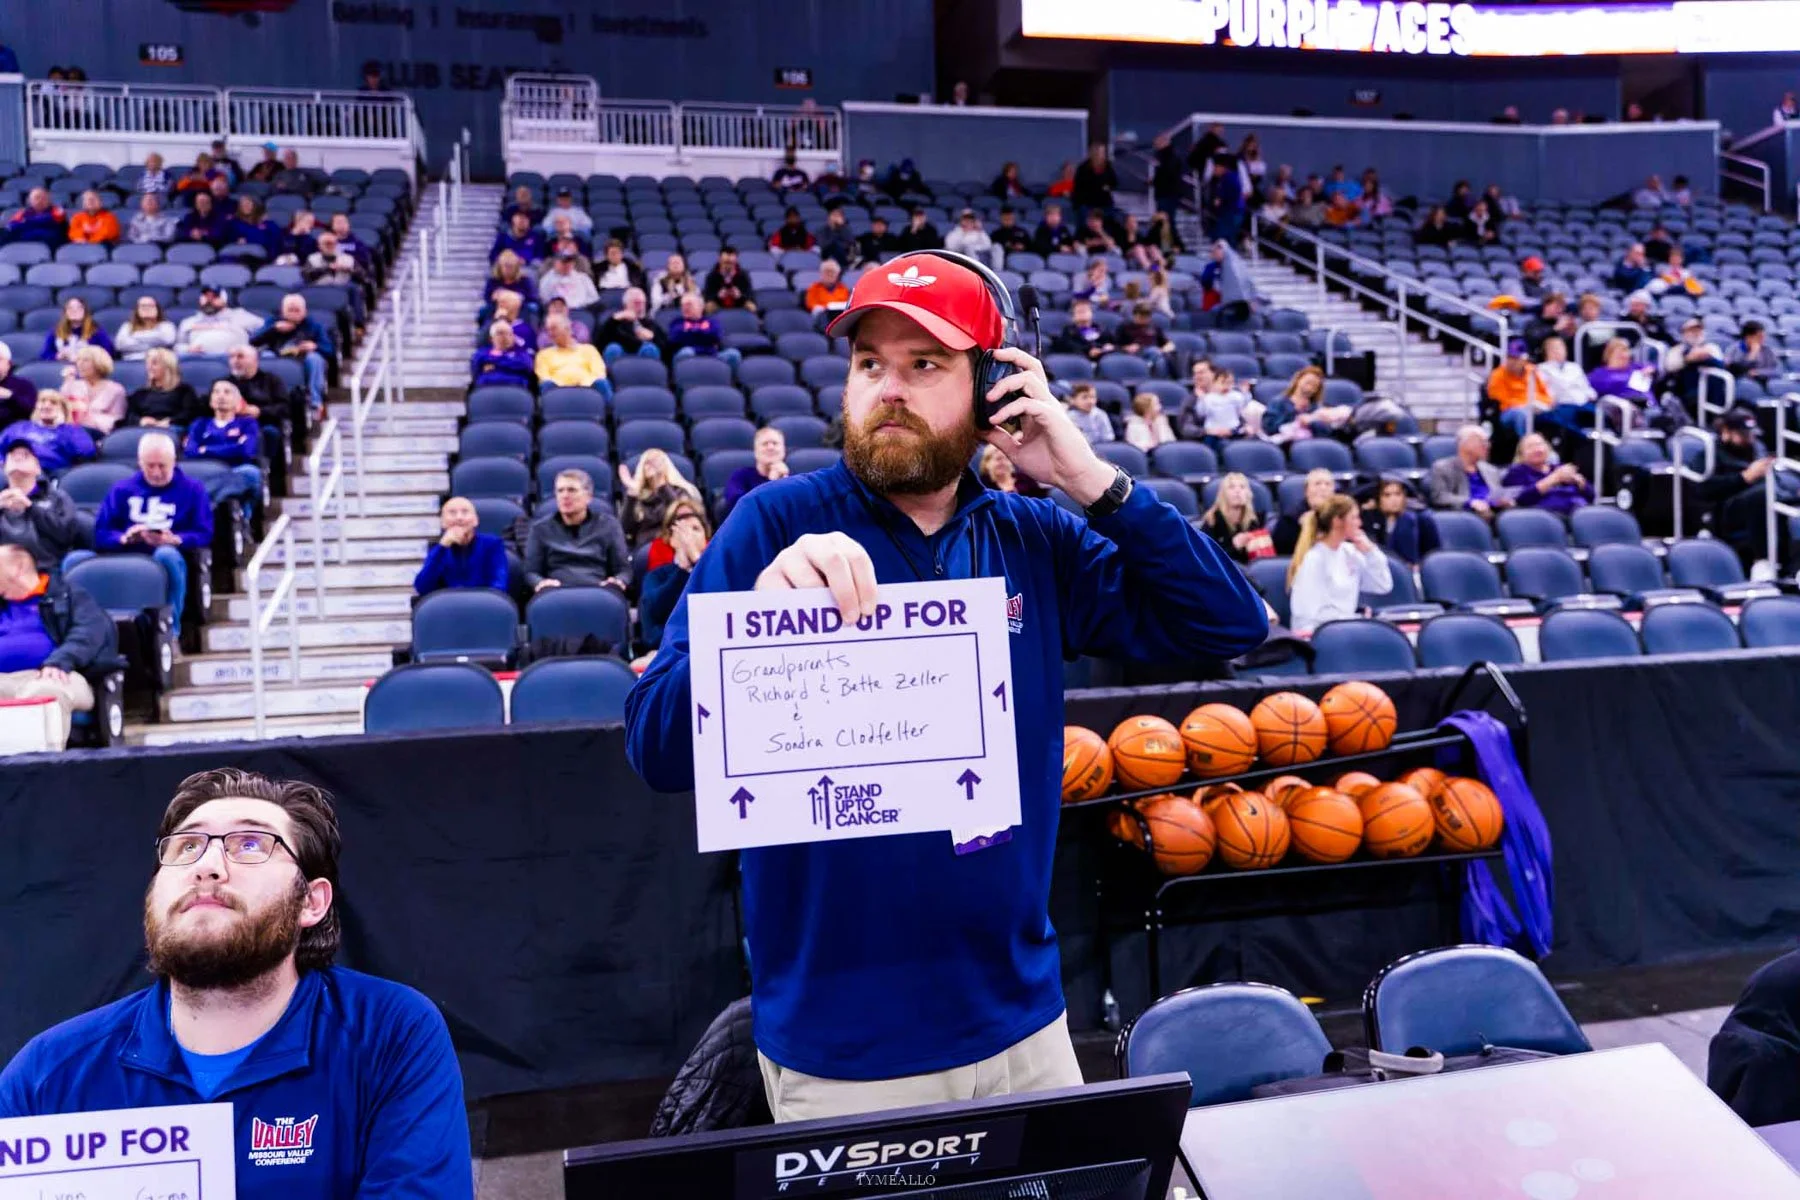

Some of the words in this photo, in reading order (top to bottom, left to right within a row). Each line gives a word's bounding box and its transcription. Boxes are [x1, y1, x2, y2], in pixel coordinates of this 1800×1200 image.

[1373, 2, 1477, 55] ACES
[726, 612, 733, 639] I
[745, 606, 843, 638] STAND
[856, 603, 892, 632] UP
[904, 599, 967, 628] FOR
[745, 678, 808, 704] Richard
[895, 668, 950, 690] Zeller
[834, 783, 882, 801] STAND
[835, 808, 899, 827] CANCER
[251, 1114, 319, 1150] VALLEY
[274, 1117, 296, 1126] THE
[65, 1132, 107, 1161] UP
[121, 1125, 190, 1156] FOR
[248, 1150, 287, 1160] MISSOURI
[287, 1148, 314, 1158] VALLEY
[255, 1156, 307, 1167] CONFERENCE
